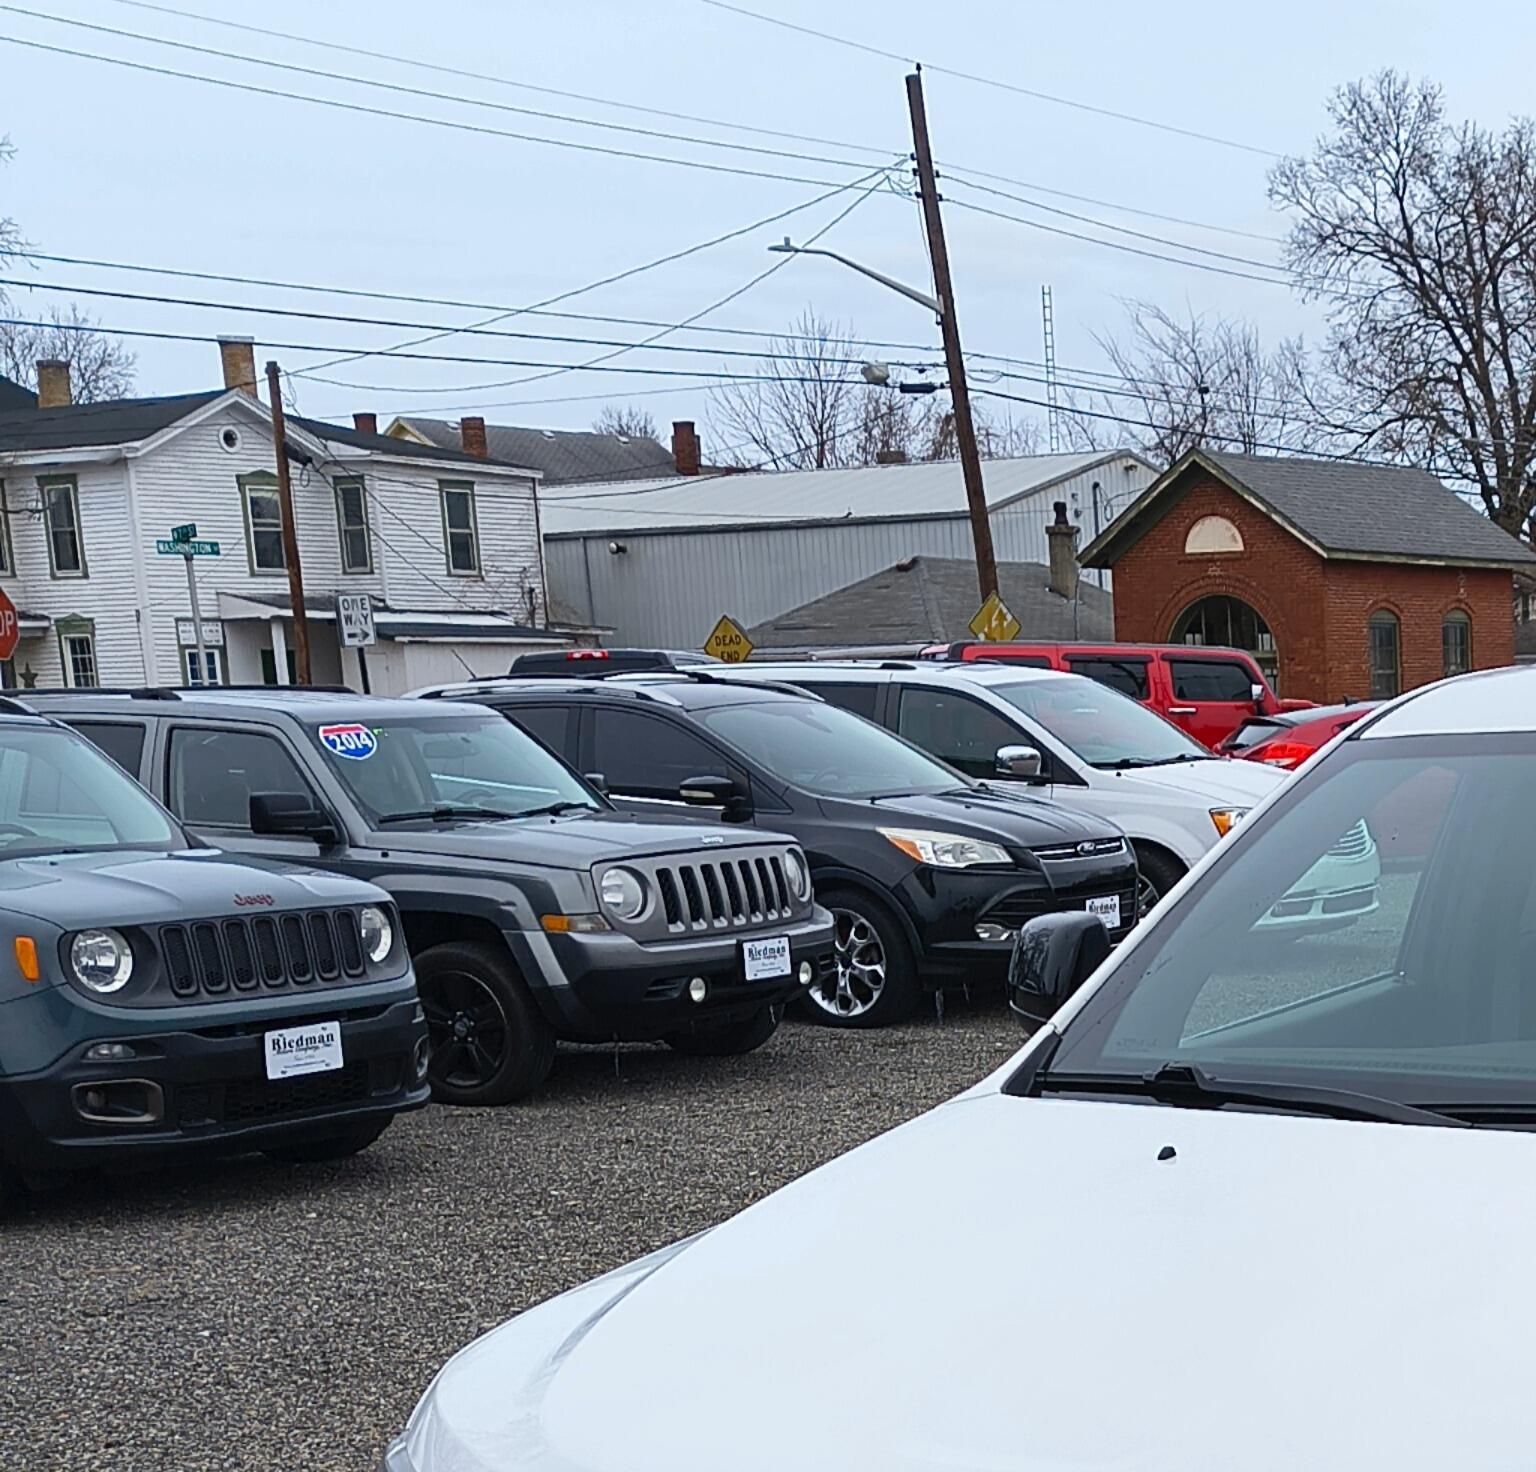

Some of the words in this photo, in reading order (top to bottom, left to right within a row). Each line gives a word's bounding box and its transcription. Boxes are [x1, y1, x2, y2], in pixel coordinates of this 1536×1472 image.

[158, 542, 212, 553] WASHINGTON
[342, 597, 368, 611] ONE
[344, 612, 369, 626] WAY
[714, 634, 742, 647] DEAD
[720, 650, 740, 662] END
[328, 732, 373, 750] 2014
[272, 1033, 334, 1051] Riedman
